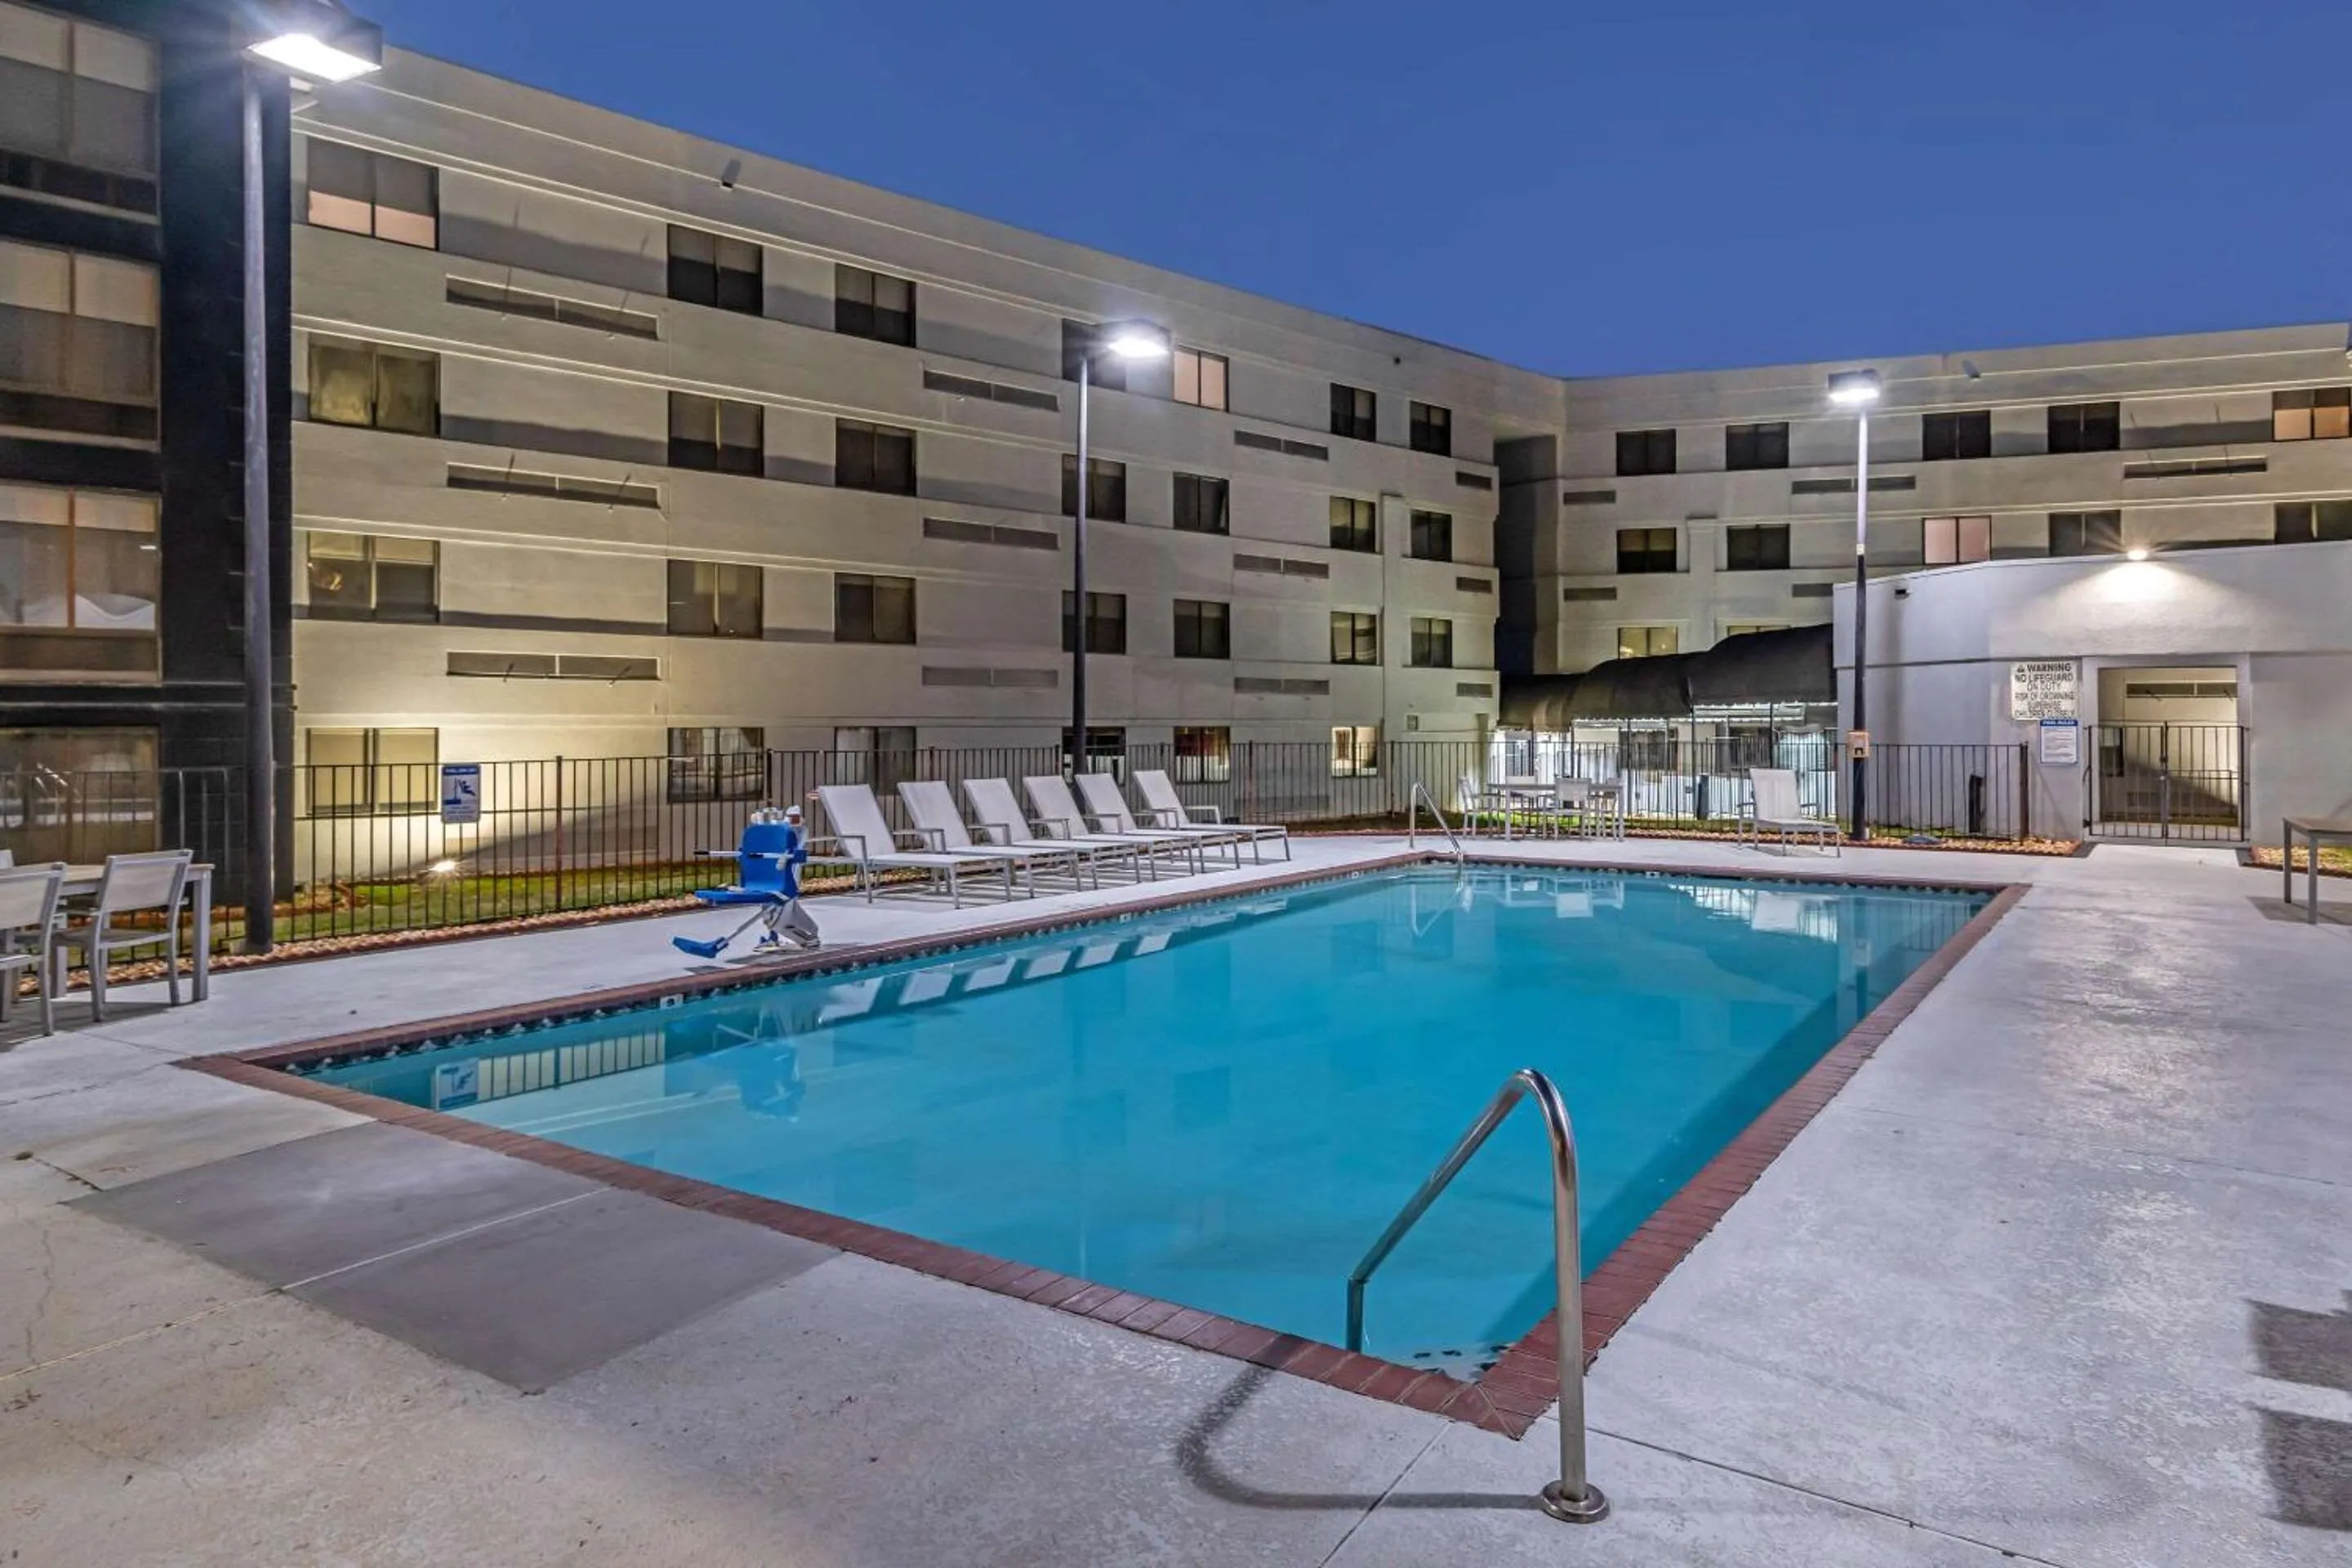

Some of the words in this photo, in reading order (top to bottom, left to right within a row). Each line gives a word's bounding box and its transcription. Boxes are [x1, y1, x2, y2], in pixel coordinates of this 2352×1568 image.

[2026, 663, 2072, 672] WARNING
[2015, 674, 2026, 683] NO
[2029, 672, 2074, 683] LIFEGUARD
[2027, 682, 2038, 692] ON
[2041, 680, 2061, 691] DUTY
